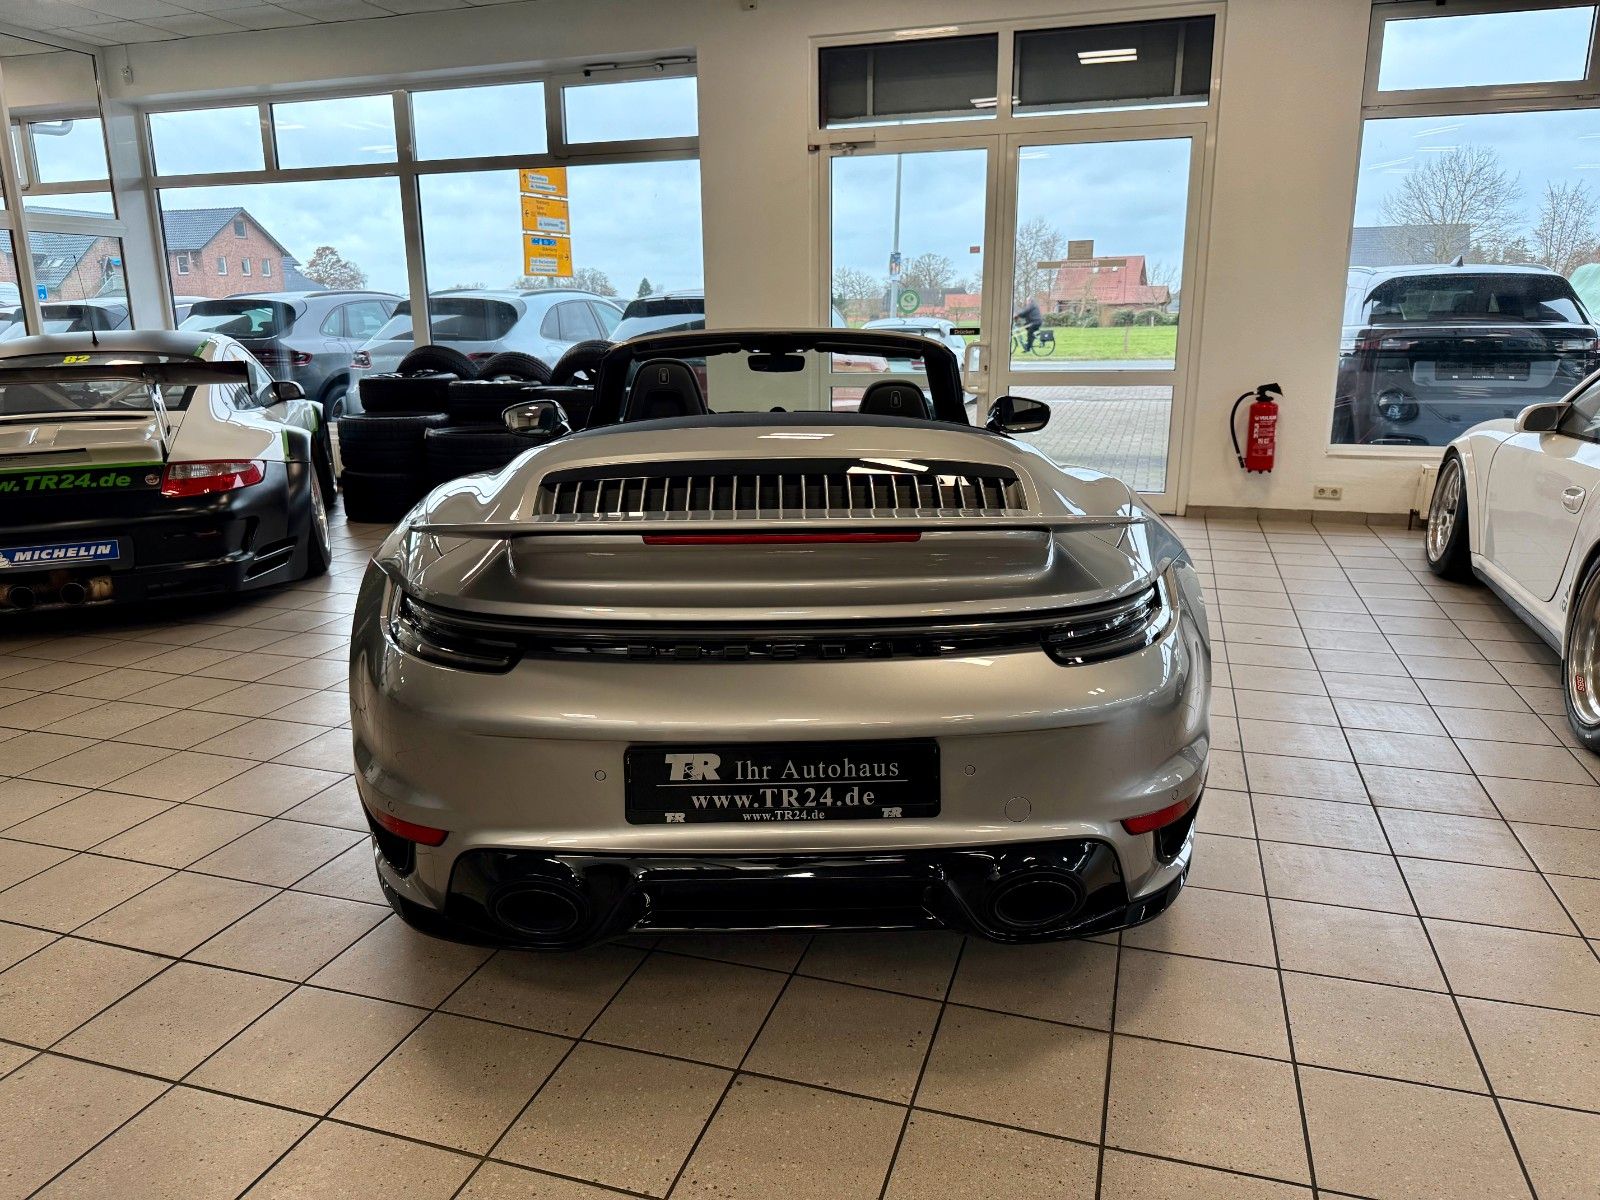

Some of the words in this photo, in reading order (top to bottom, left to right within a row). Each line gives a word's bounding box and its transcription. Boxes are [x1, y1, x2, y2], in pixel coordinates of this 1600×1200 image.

[63, 355, 90, 364] 82
[13, 545, 112, 562] MICHELIN
[735, 760, 772, 780] Ihr
[780, 758, 900, 779] Autohaus
[691, 786, 876, 809] www.TR24.de
[742, 809, 826, 821] www.TR24.de
